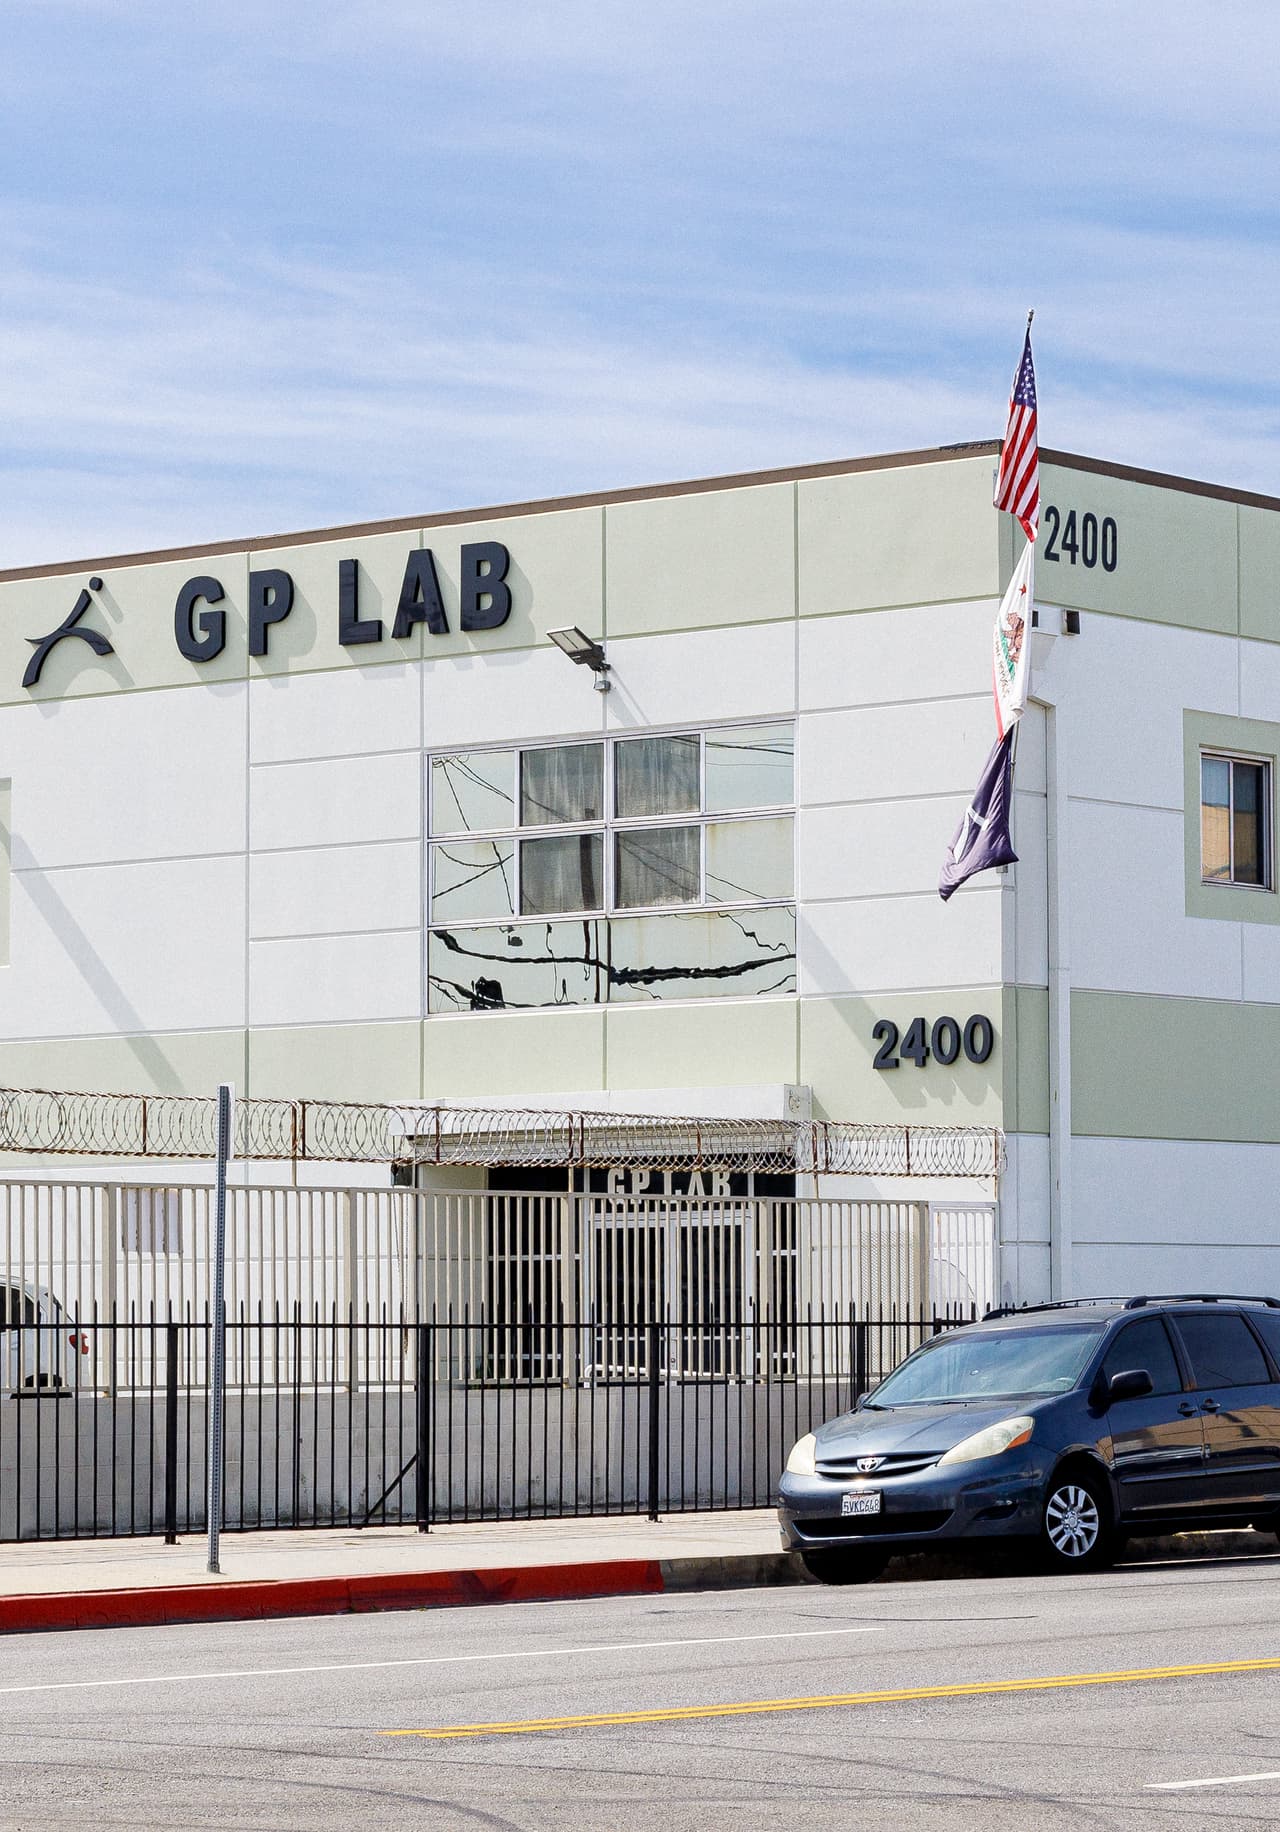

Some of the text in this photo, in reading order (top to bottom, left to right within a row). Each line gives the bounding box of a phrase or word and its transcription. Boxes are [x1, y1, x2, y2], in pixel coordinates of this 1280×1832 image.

[1044, 505, 1118, 573] 2400
[174, 541, 513, 663] GP LAB
[872, 1014, 994, 1069] 2400
